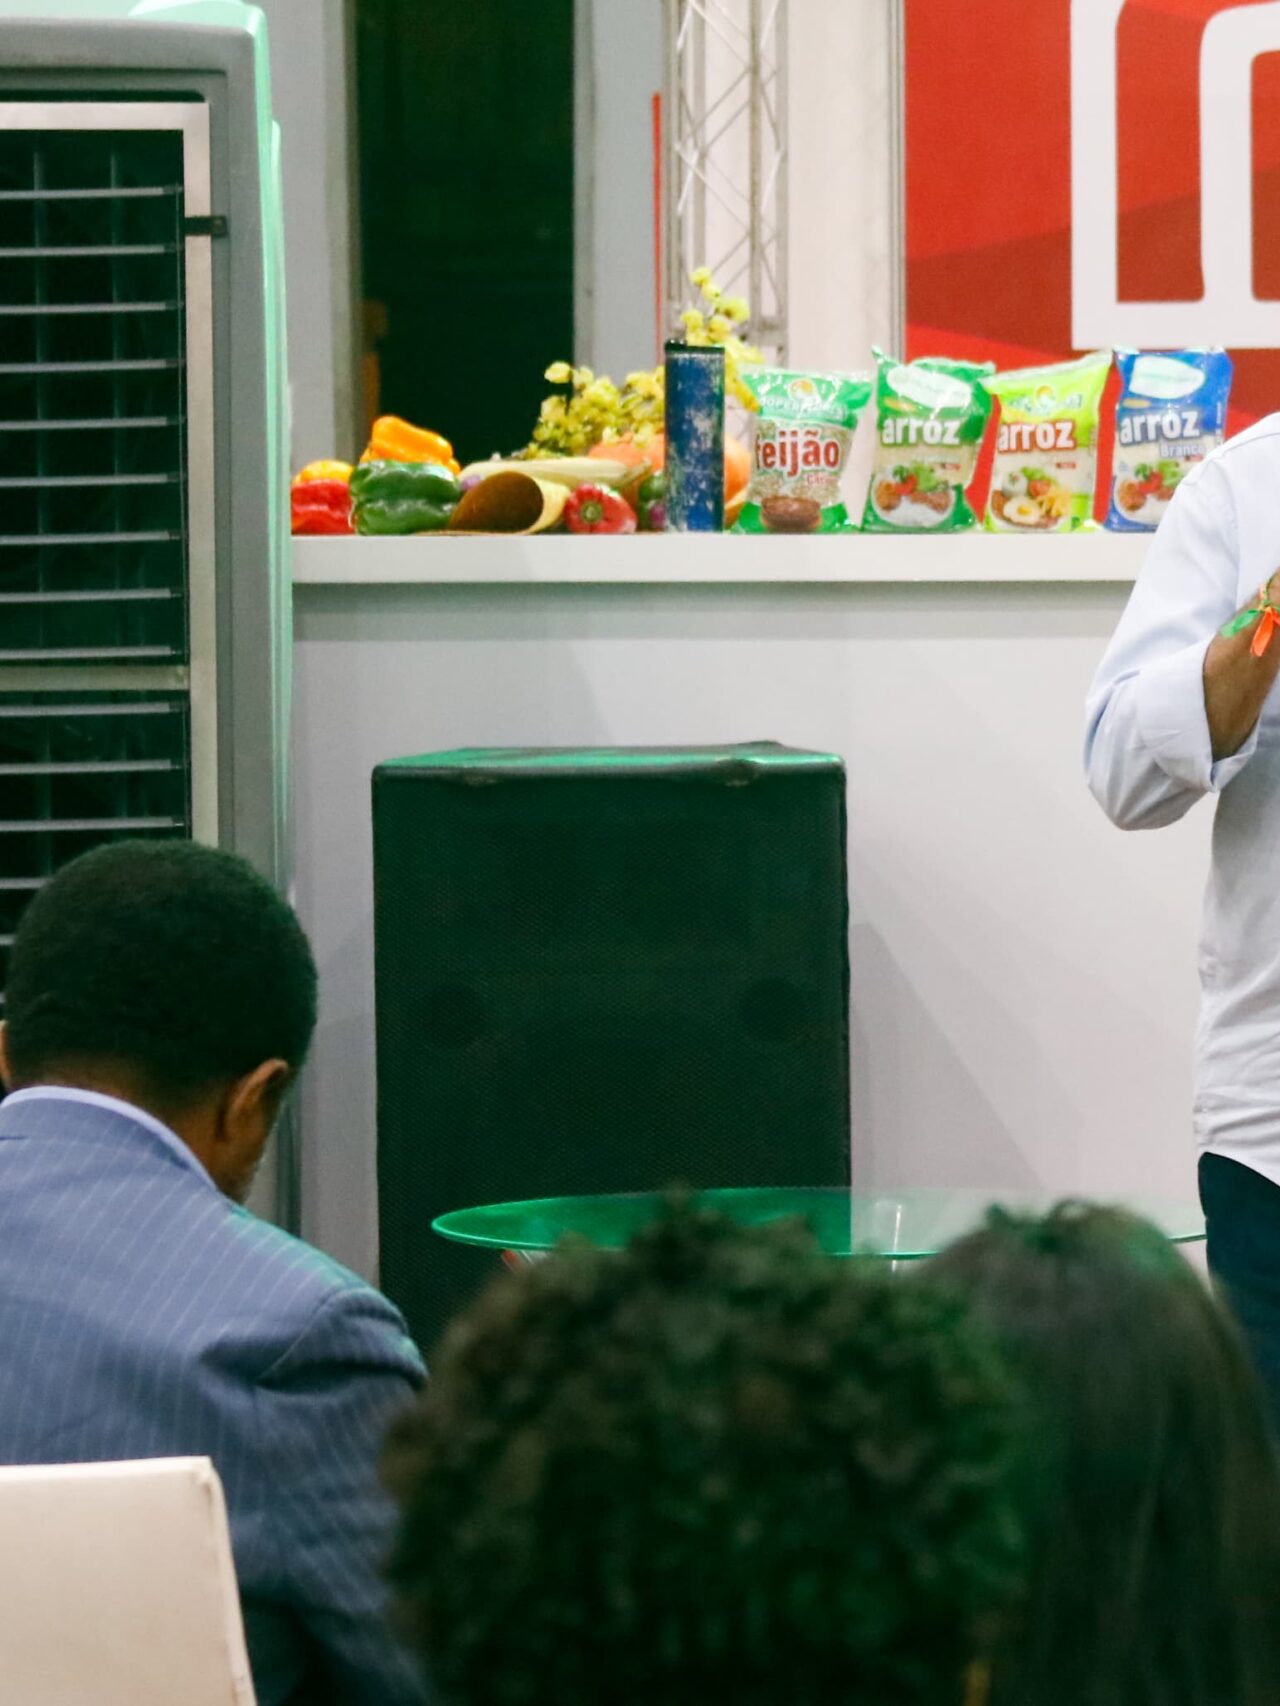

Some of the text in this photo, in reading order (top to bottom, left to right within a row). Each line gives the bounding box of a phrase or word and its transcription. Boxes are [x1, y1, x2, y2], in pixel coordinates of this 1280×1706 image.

[882, 417, 961, 445] arroz
[998, 420, 1076, 451] arroz
[1119, 410, 1201, 445] arroz
